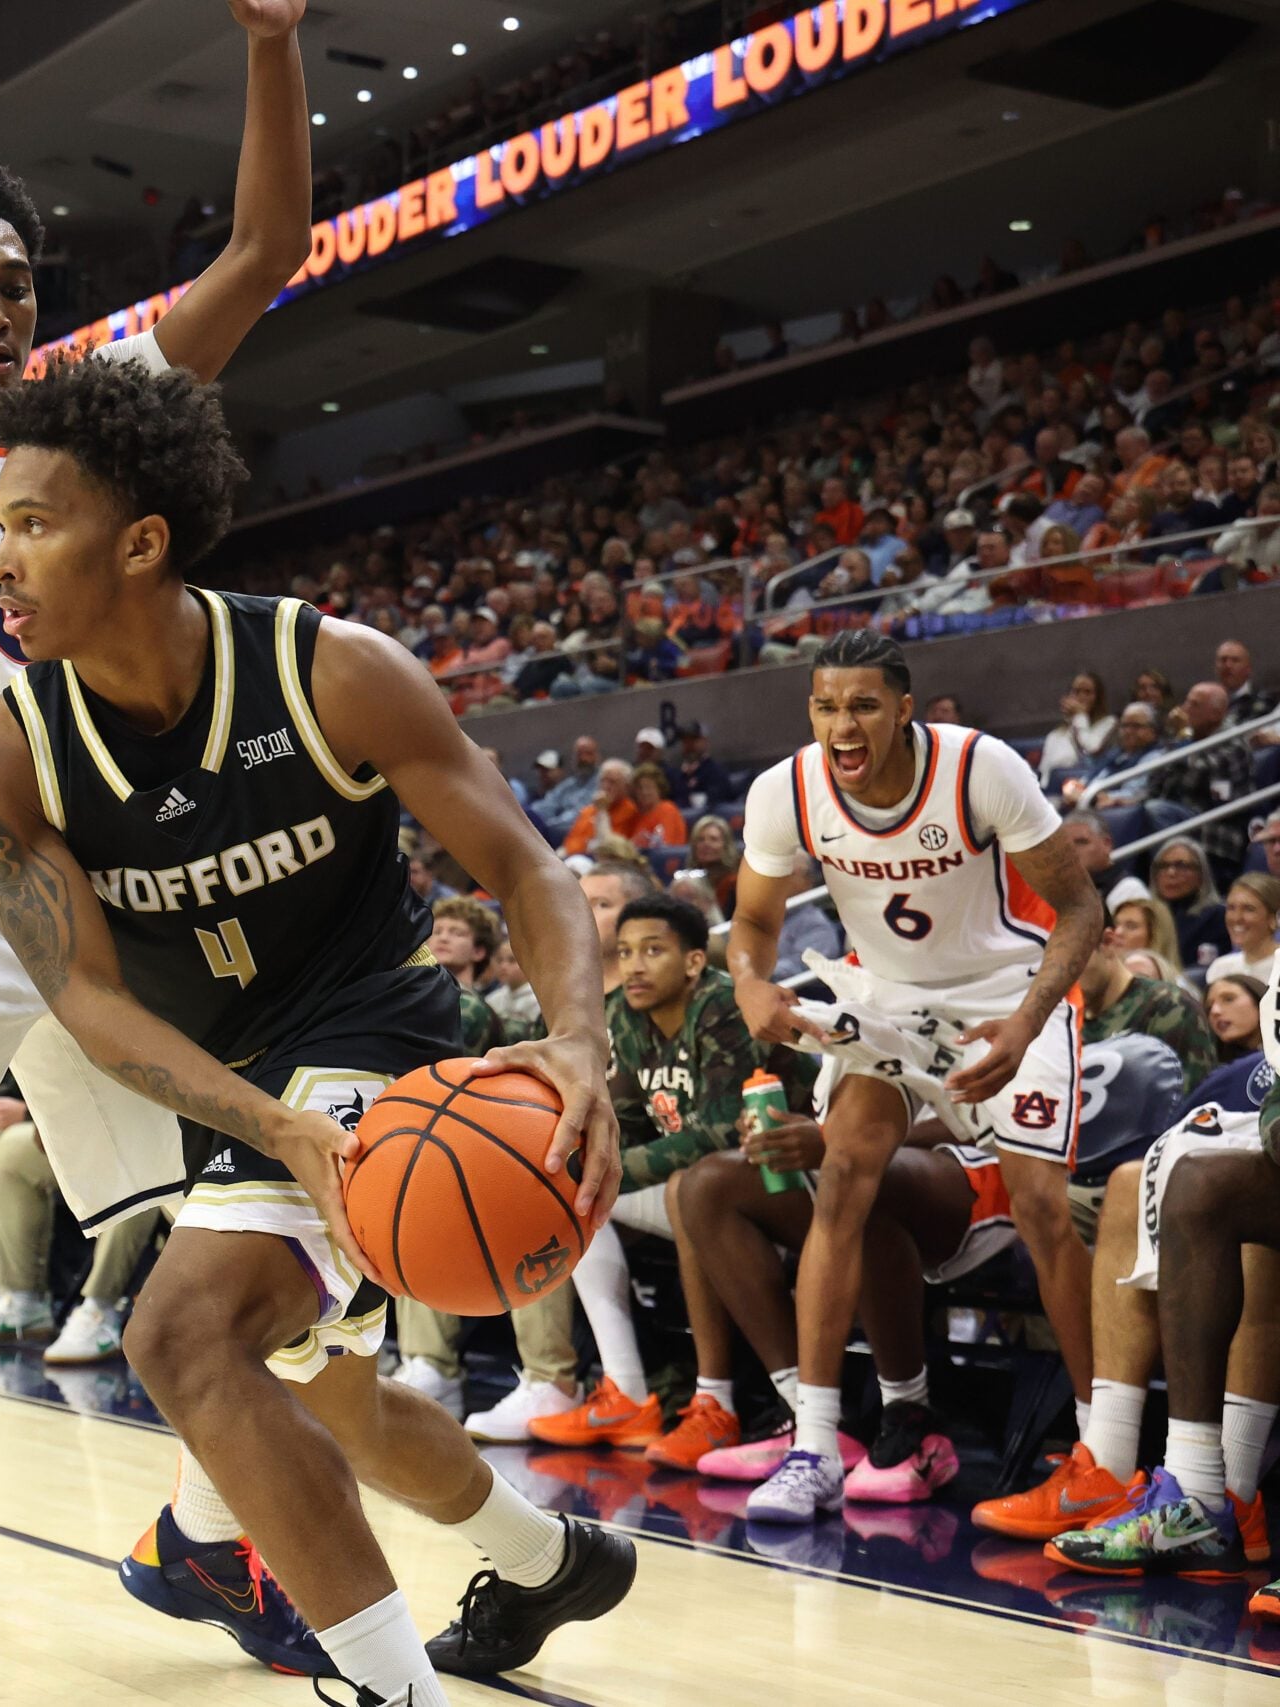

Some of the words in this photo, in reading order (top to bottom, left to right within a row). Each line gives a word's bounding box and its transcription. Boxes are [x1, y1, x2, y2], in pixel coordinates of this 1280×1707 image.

[476, 64, 691, 208] LOUDER
[712, 0, 980, 110] LOUDE
[236, 727, 296, 770] SOCON
[155, 800, 197, 822] adidas
[920, 826, 947, 850] SEC
[820, 850, 964, 882] AUBURN
[883, 892, 933, 941] 6
[193, 917, 258, 990] 4
